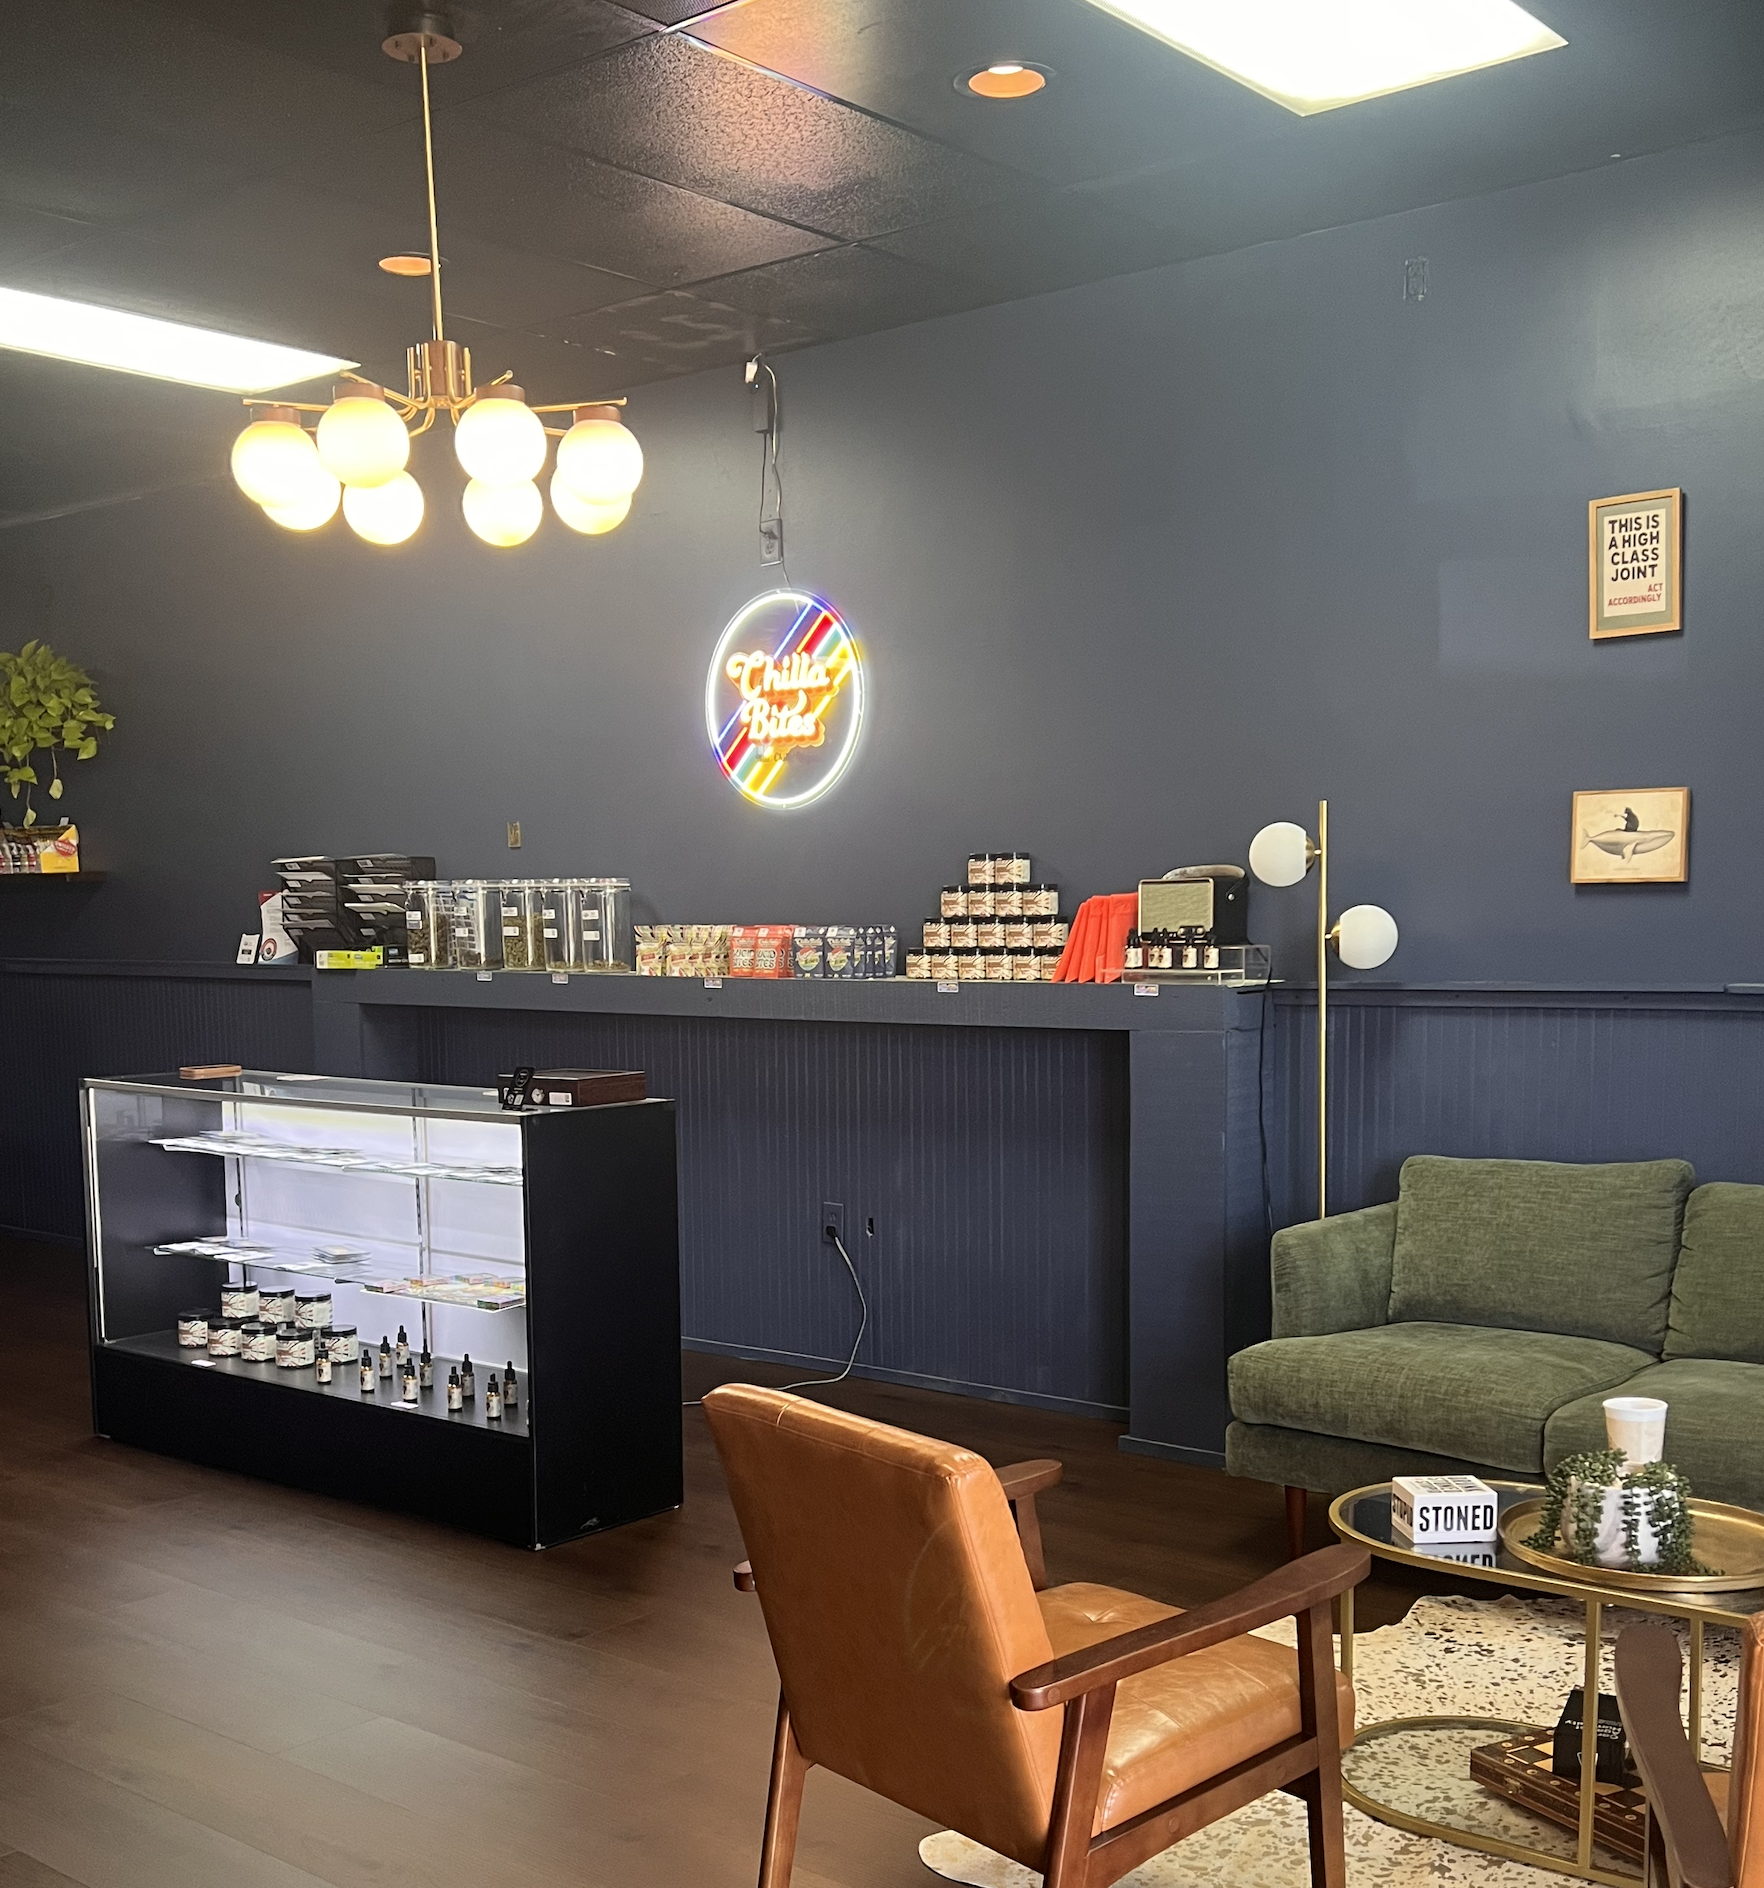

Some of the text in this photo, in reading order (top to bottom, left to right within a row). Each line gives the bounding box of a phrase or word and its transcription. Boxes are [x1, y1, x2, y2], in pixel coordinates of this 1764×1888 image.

[1608, 514, 1659, 534] THIS IS
[1608, 530, 1659, 550] A HIGH
[1611, 547, 1659, 566] CLASS
[1611, 564, 1658, 582] JOINT
[1647, 582, 1663, 593] ACT
[1608, 592, 1662, 607] ACCORDINGLY
[726, 650, 831, 700] Chilla
[740, 690, 818, 740] Bites
[1419, 1504, 1494, 1532] STONED
